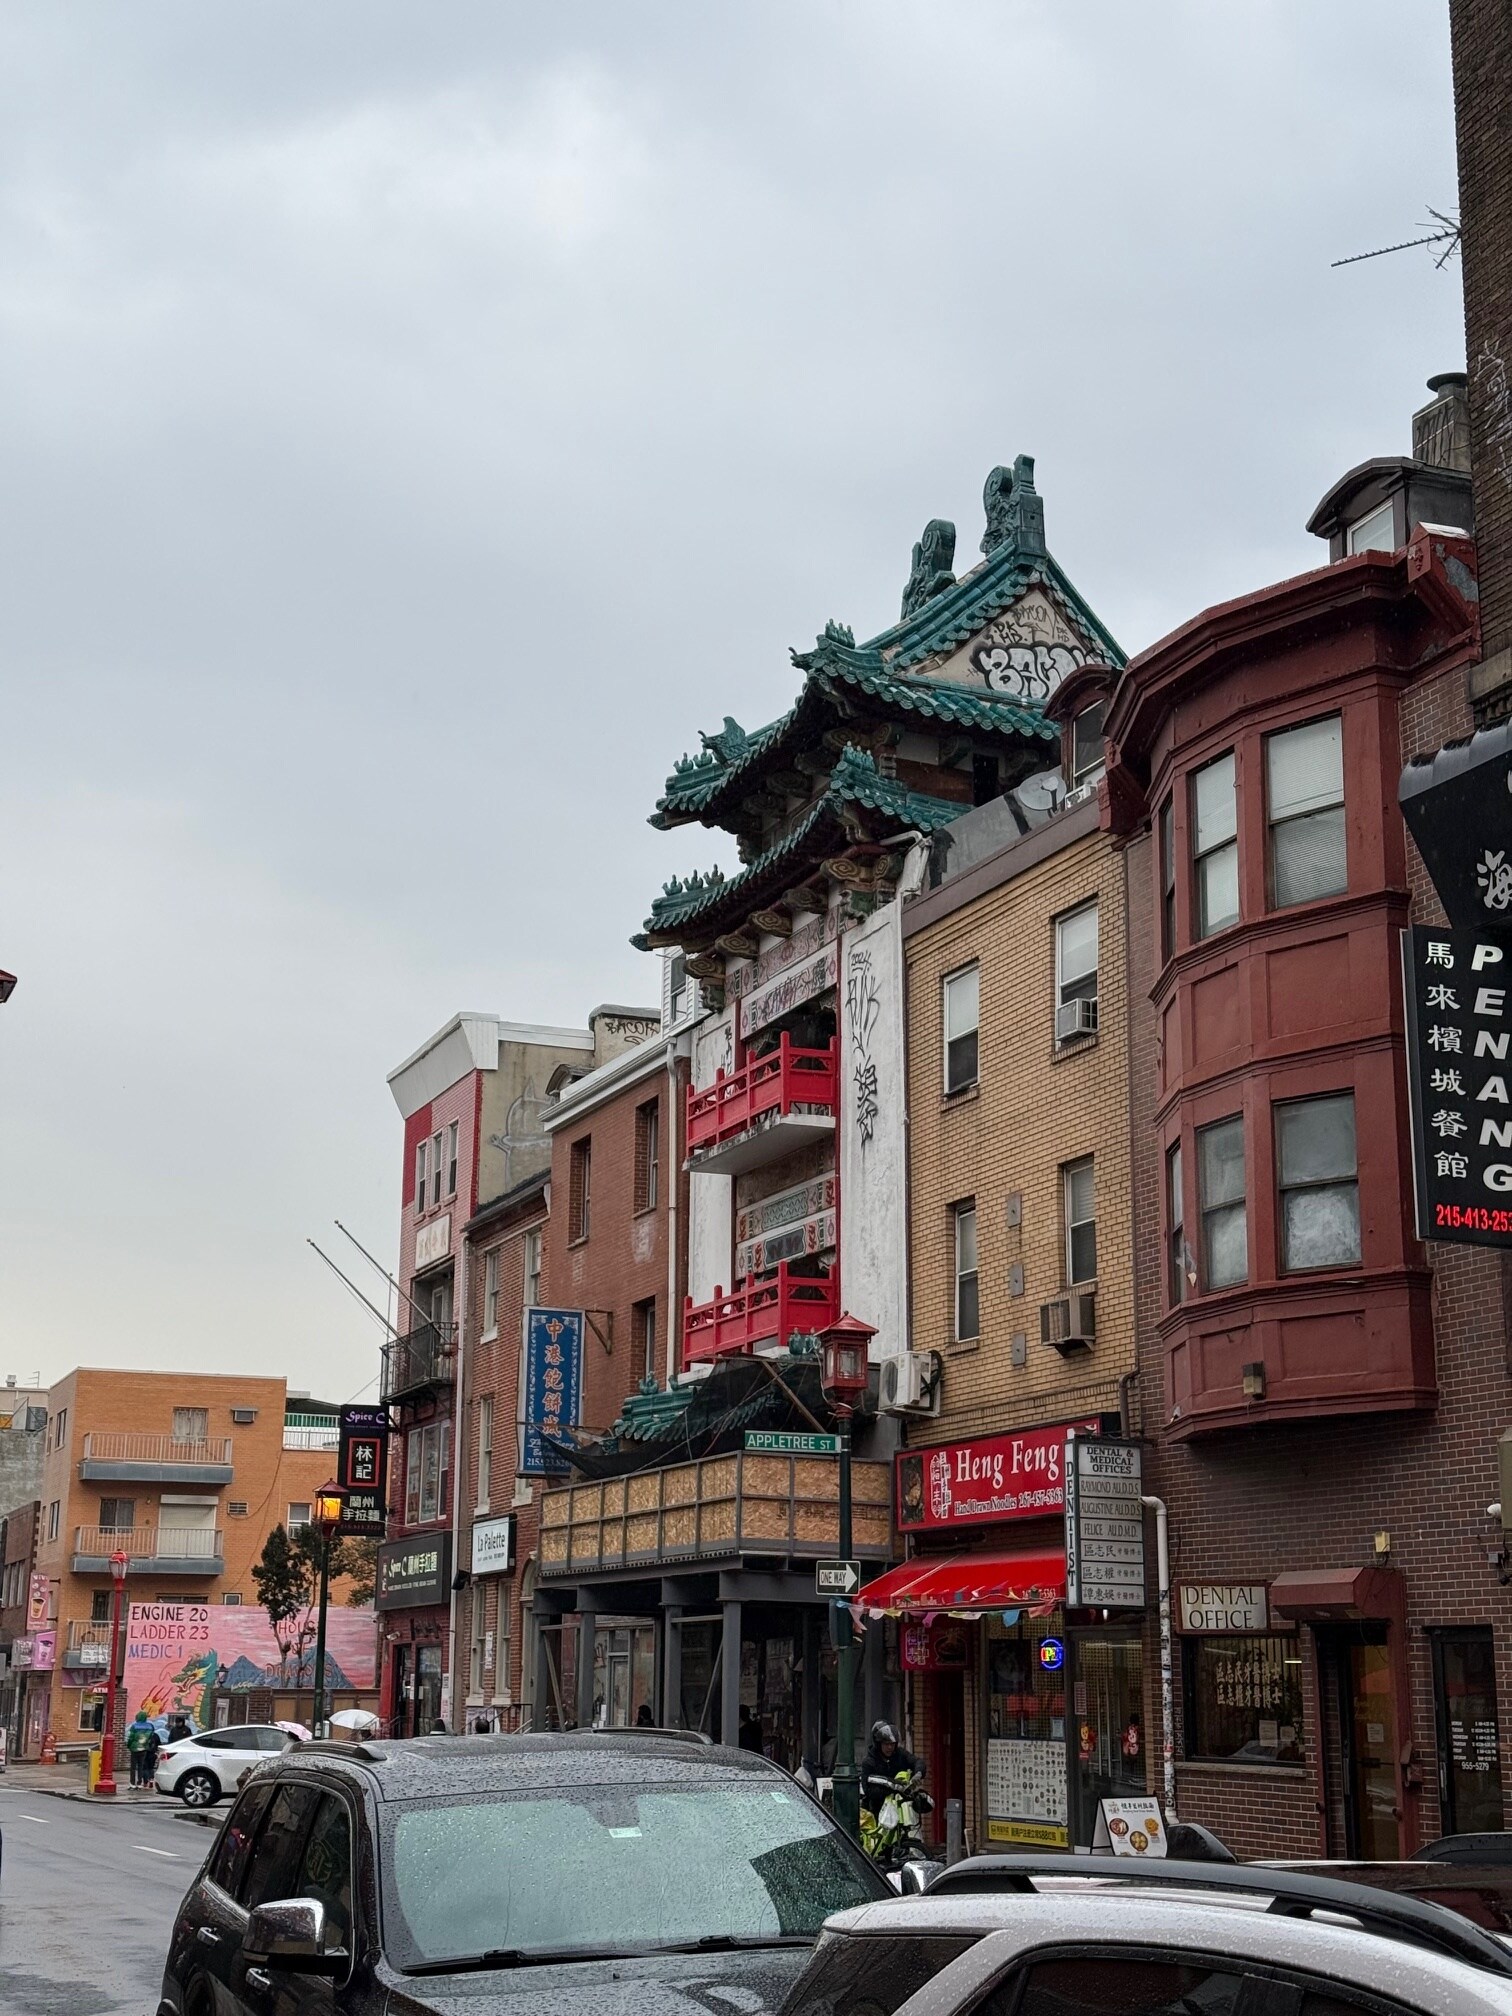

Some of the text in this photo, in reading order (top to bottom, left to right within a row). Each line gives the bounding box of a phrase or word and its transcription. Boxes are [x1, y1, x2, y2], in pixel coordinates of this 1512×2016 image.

[345, 1410, 385, 1424] Spice C
[747, 1434, 831, 1450] APPLETREE ST
[1087, 1447, 1134, 1458] DENTAL &
[355, 1445, 373, 1479] 林記
[955, 1449, 1004, 1489] Heng
[1010, 1440, 1060, 1481] Feng
[1090, 1455, 1133, 1466] MEDICAL
[1092, 1464, 1132, 1474] OFFICES
[1080, 1480, 1111, 1493] RAYMOND
[1081, 1502, 1113, 1515] AUGUSTINE
[1066, 1461, 1076, 1587] DENTIST
[1084, 1523, 1103, 1536] FELICE
[477, 1531, 506, 1552] La Palette
[821, 1571, 847, 1584] ONE WAY
[1185, 1586, 1258, 1605] DENTAL
[131, 1606, 208, 1622] ENGINE 20
[1189, 1610, 1253, 1629] OFFICE
[130, 1625, 209, 1640] LADDER 23
[128, 1643, 183, 1659] MEDIC 1
